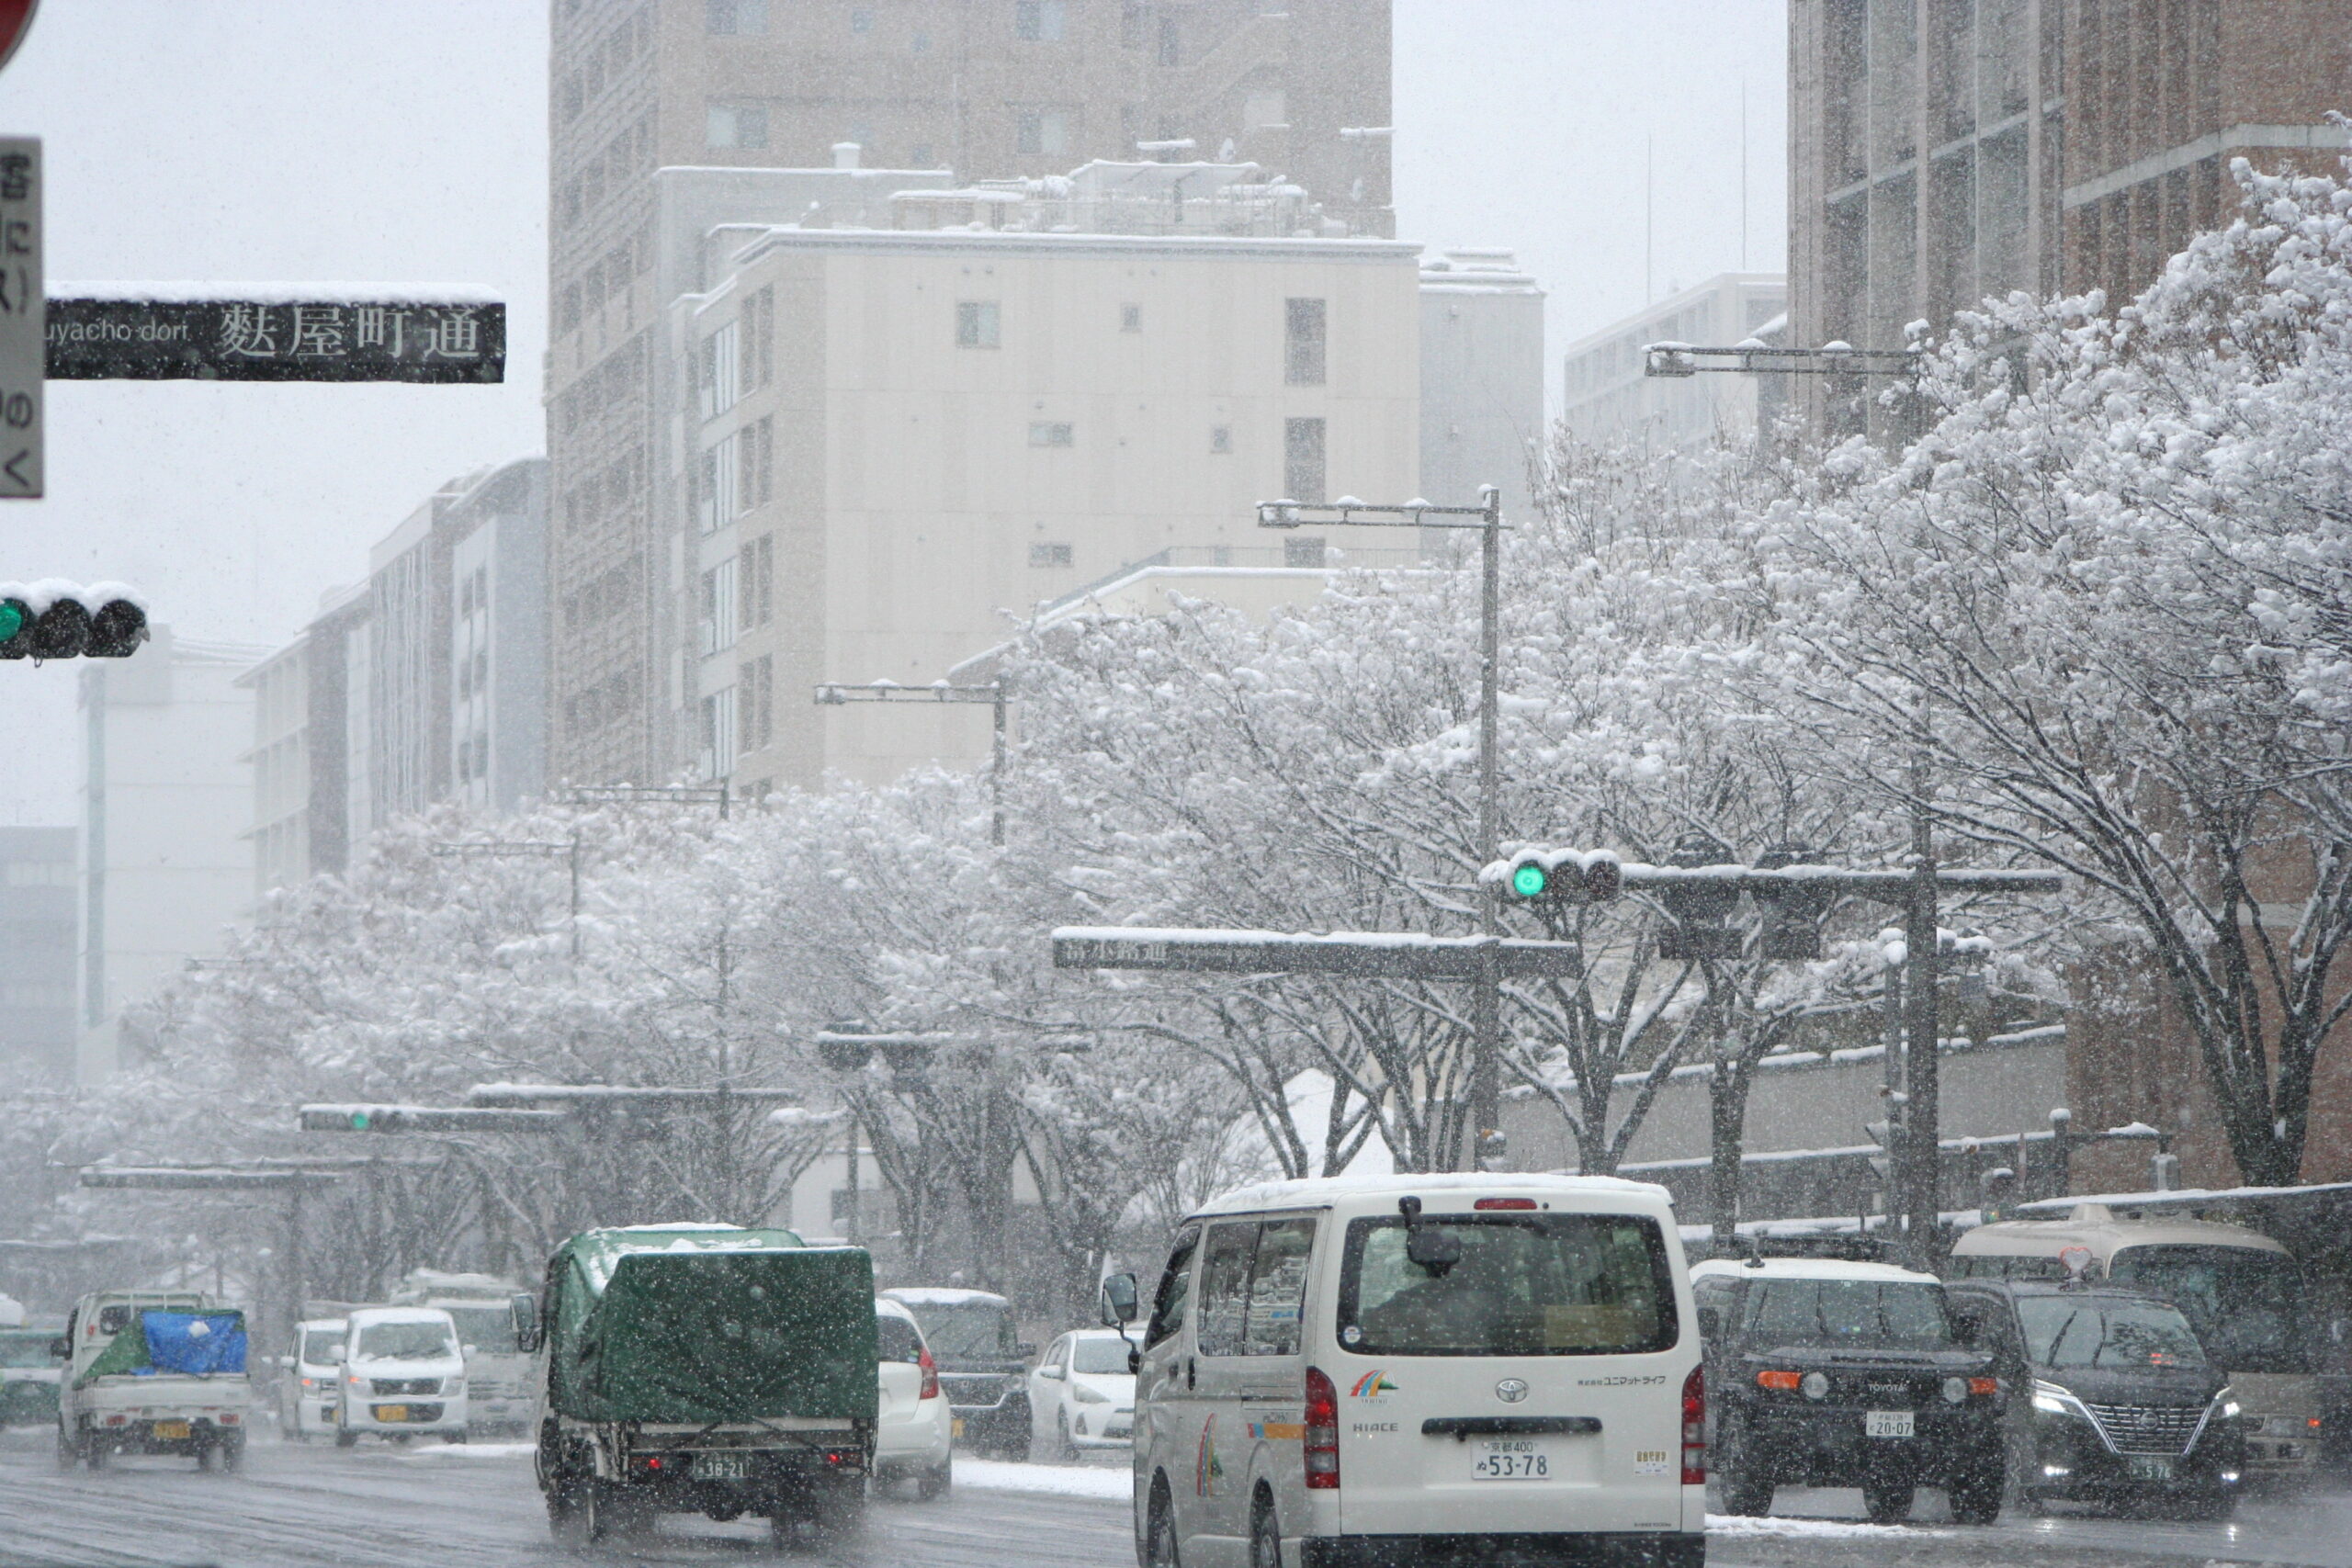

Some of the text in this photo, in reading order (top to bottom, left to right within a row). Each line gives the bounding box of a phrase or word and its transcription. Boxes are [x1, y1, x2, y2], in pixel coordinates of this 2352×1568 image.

[220, 305, 480, 358] 麩屋町通
[1868, 1383, 1905, 1392] TOYOTA
[1353, 1423, 1398, 1432] HIACE
